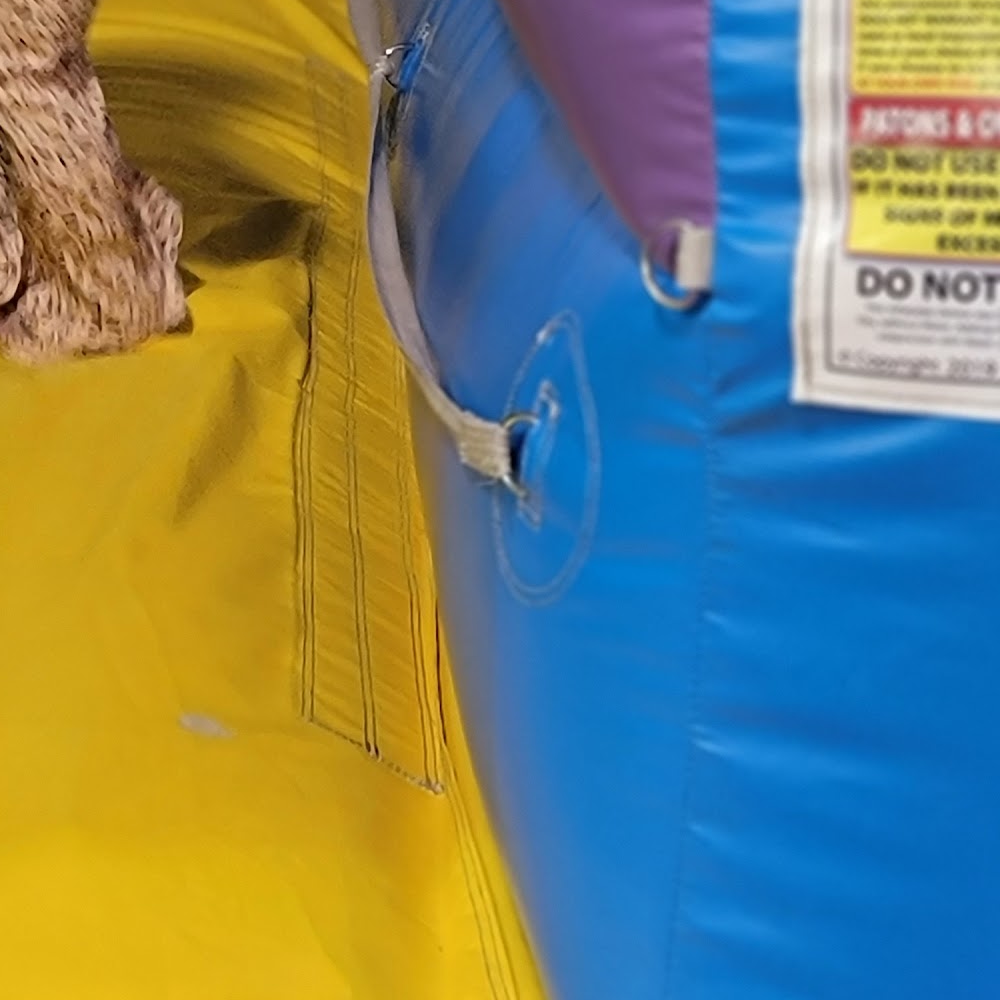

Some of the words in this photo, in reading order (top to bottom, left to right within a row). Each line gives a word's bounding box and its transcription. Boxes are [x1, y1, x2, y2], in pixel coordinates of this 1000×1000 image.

[851, 150, 888, 172] DO
[894, 151, 944, 174] NOT
[950, 152, 998, 175] USE
[856, 265, 914, 301] DO
[922, 269, 1000, 305] NOT
